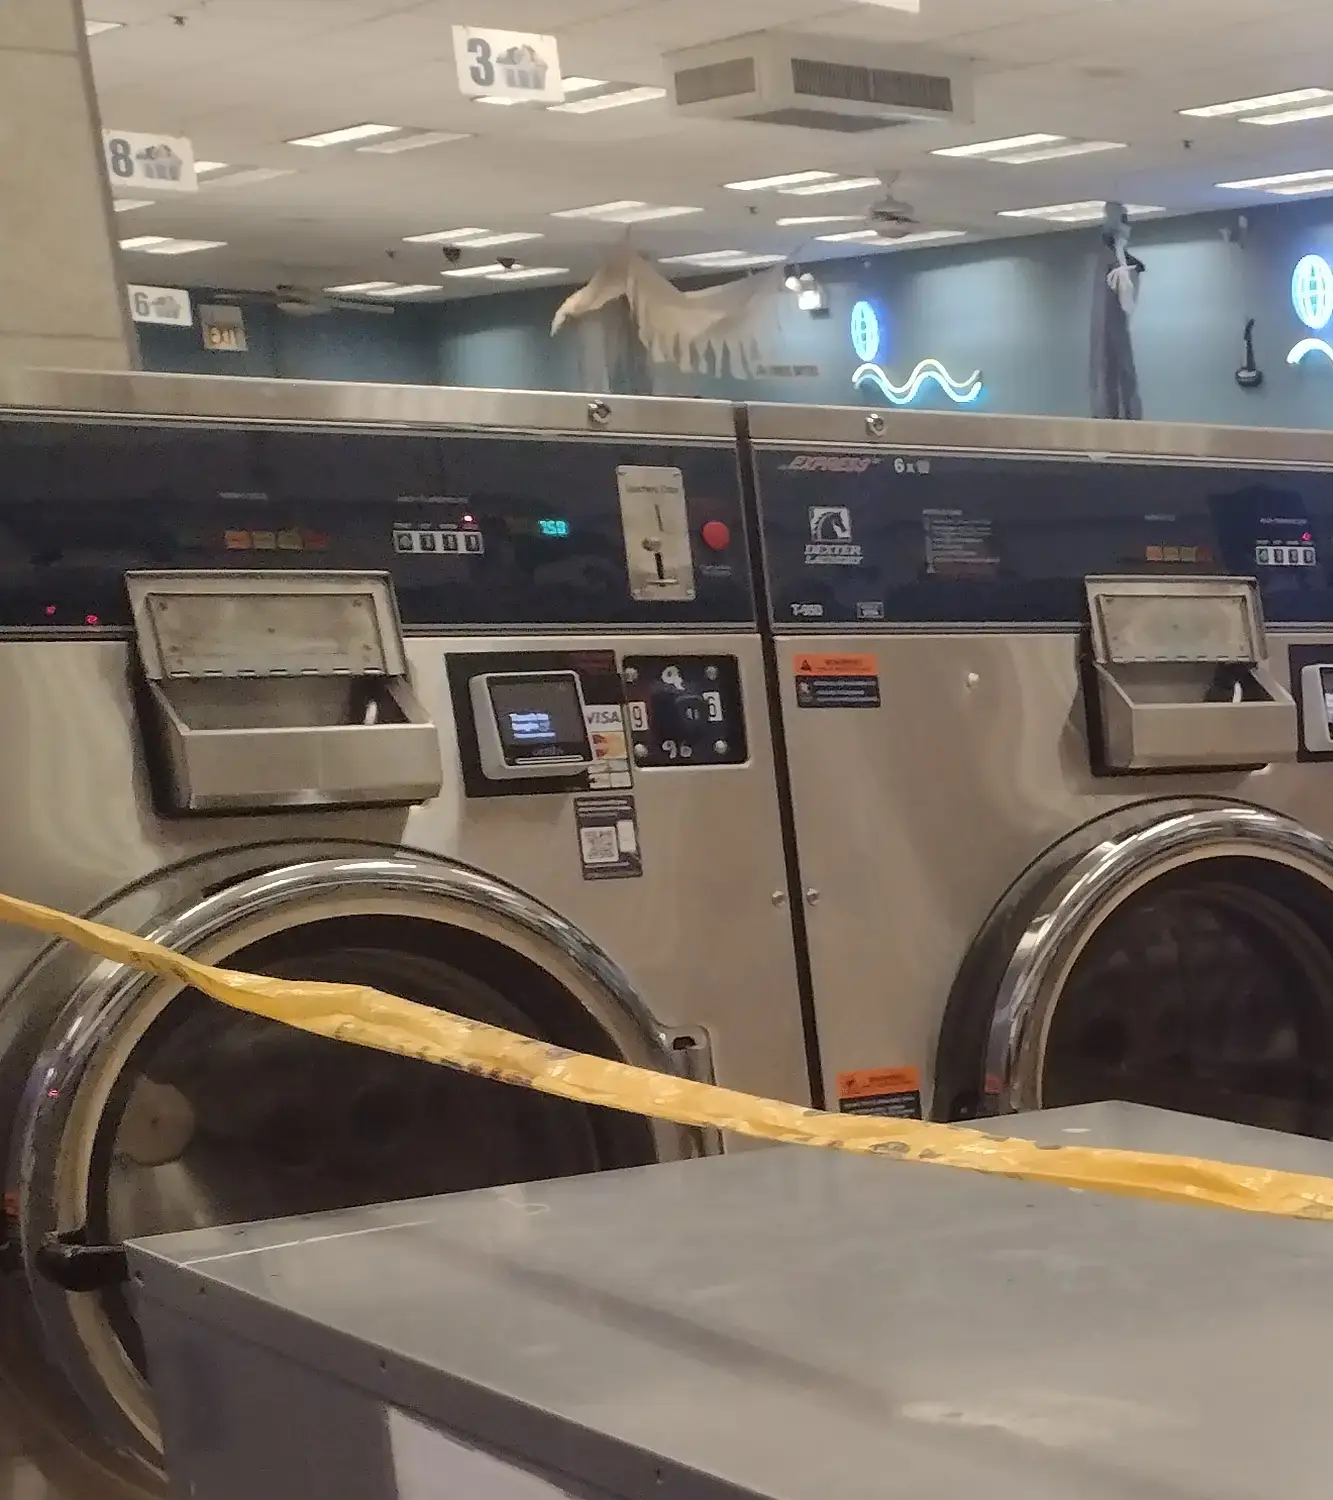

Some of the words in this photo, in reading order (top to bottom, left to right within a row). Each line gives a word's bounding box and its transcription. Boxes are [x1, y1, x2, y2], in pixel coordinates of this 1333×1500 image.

[467, 37, 495, 87] 3
[109, 138, 134, 177] 8
[134, 291, 150, 317] 6
[586, 709, 622, 725] VISA
